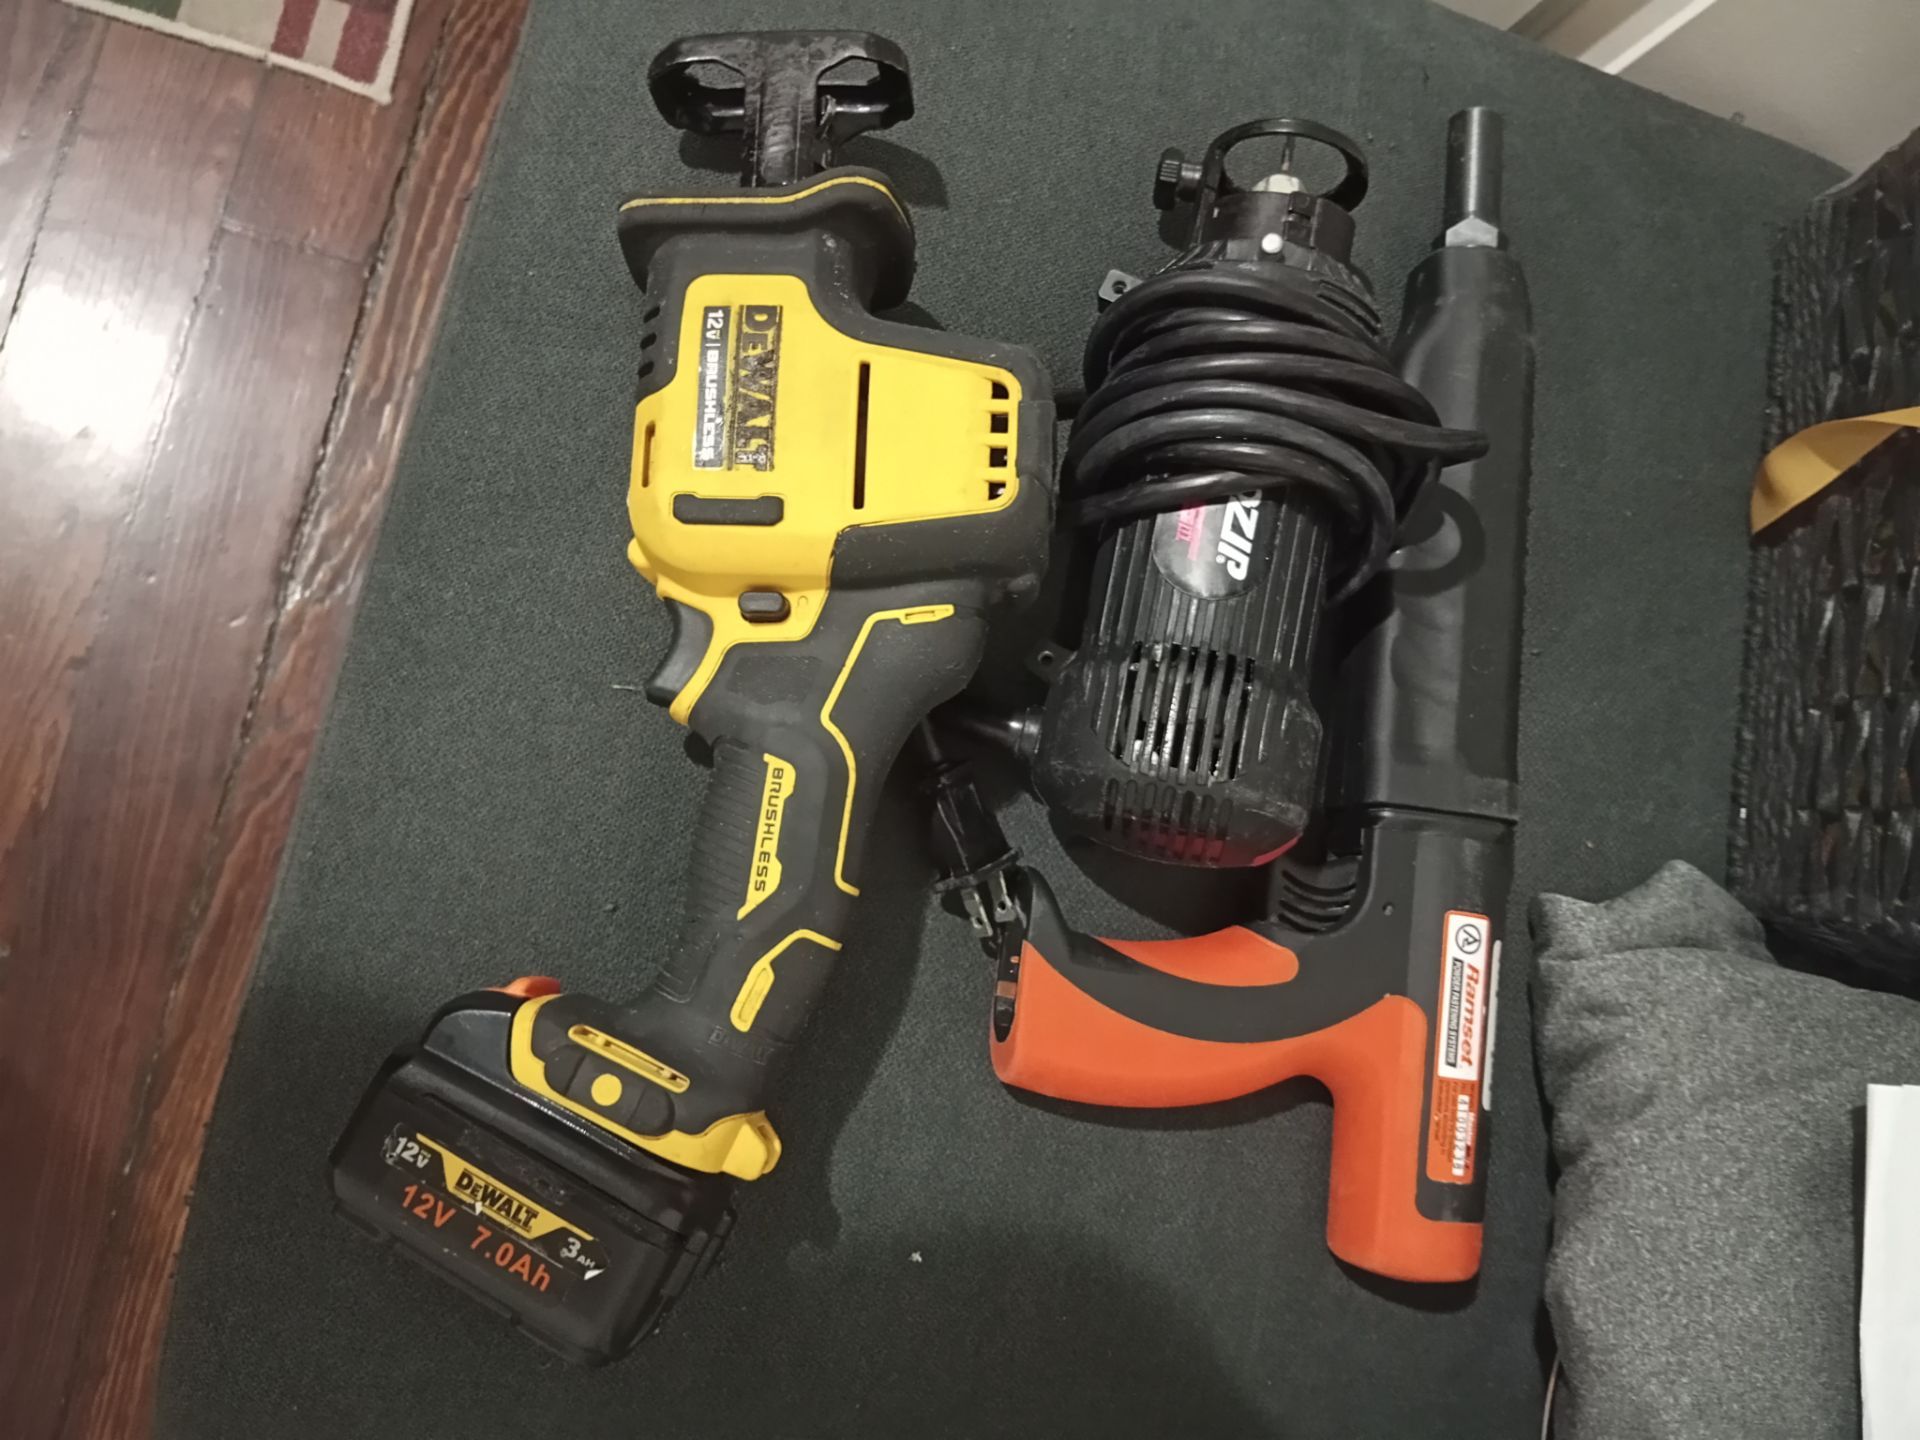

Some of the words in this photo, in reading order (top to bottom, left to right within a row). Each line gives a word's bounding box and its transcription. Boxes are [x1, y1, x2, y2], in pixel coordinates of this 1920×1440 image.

[701, 349, 719, 461] BRUSHLESS
[754, 767, 784, 892] BRUSHLESS
[1449, 991, 1461, 1030] FASTENING
[1452, 960, 1463, 991] POWDER
[1447, 1030, 1458, 1064] SYSTEMS
[1460, 962, 1480, 1067] Ramset
[394, 1137, 431, 1168] 12V
[402, 1185, 457, 1228] 12V
[470, 1226, 552, 1292] 7.0Ah
